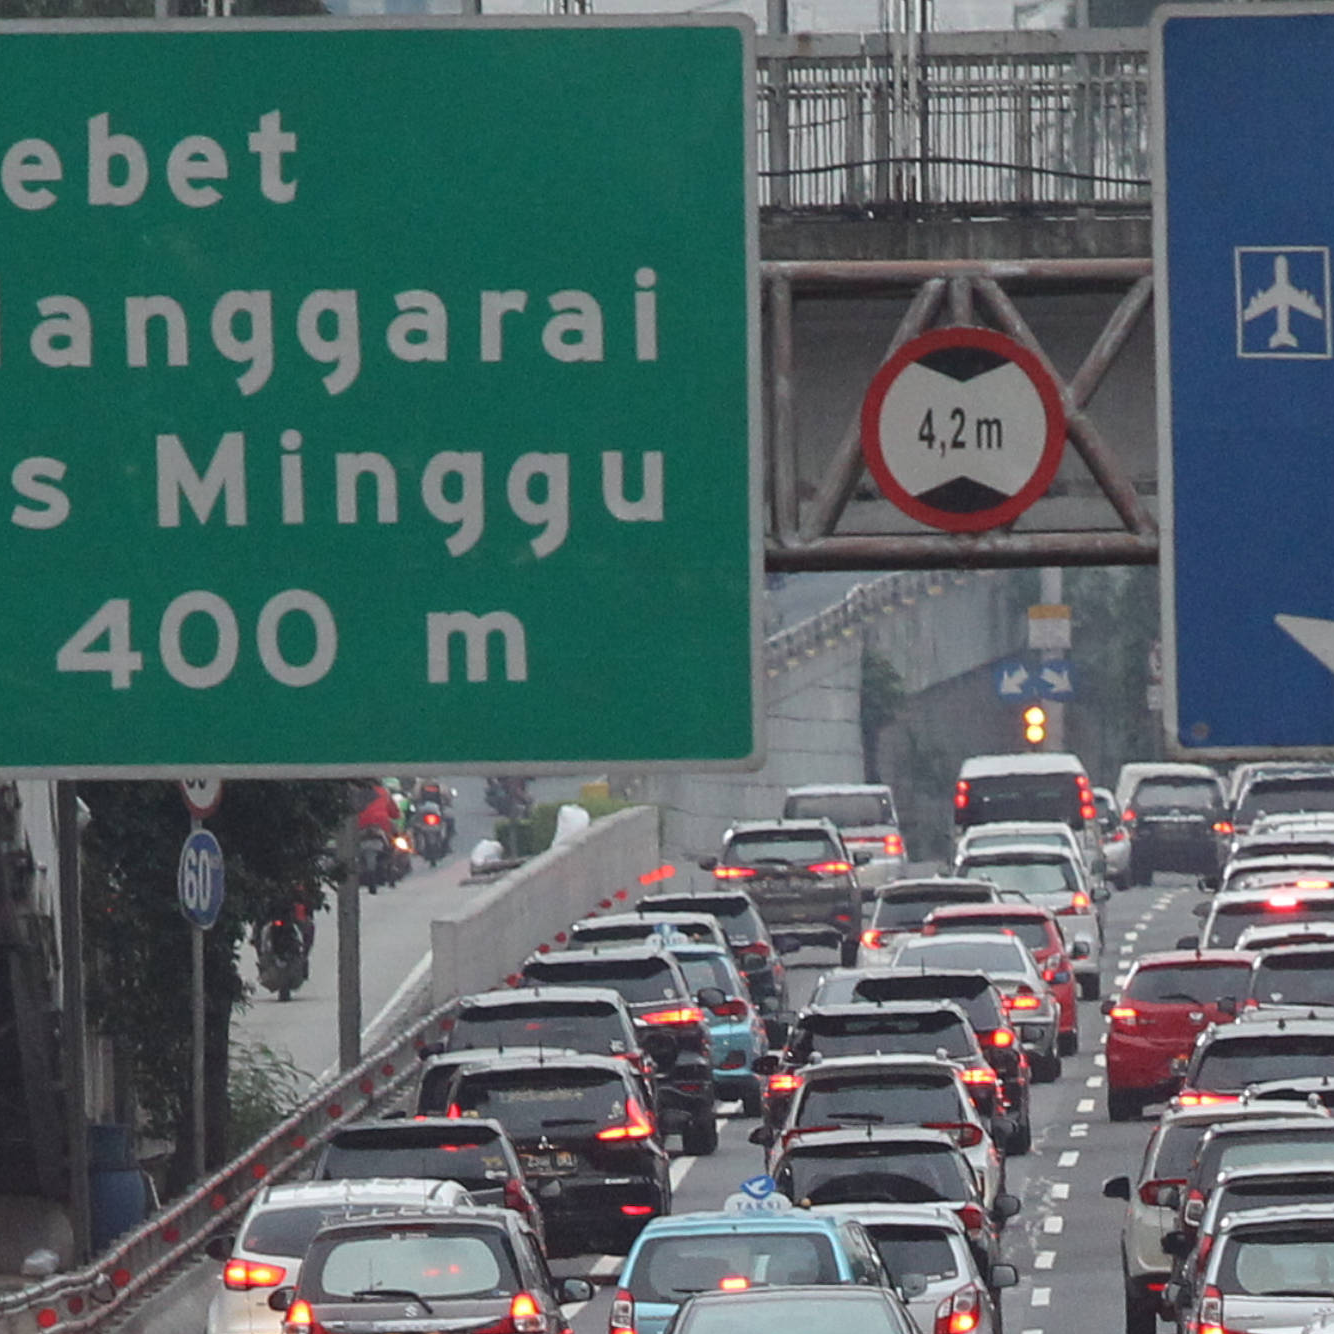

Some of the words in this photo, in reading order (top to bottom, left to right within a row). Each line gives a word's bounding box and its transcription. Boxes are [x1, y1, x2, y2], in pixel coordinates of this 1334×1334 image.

[918, 407, 966, 458] 4,2
[976, 417, 1003, 449] m
[156, 430, 664, 558] Minggu
[57, 590, 338, 689] 400
[426, 611, 527, 684] m
[184, 847, 212, 911] 60
